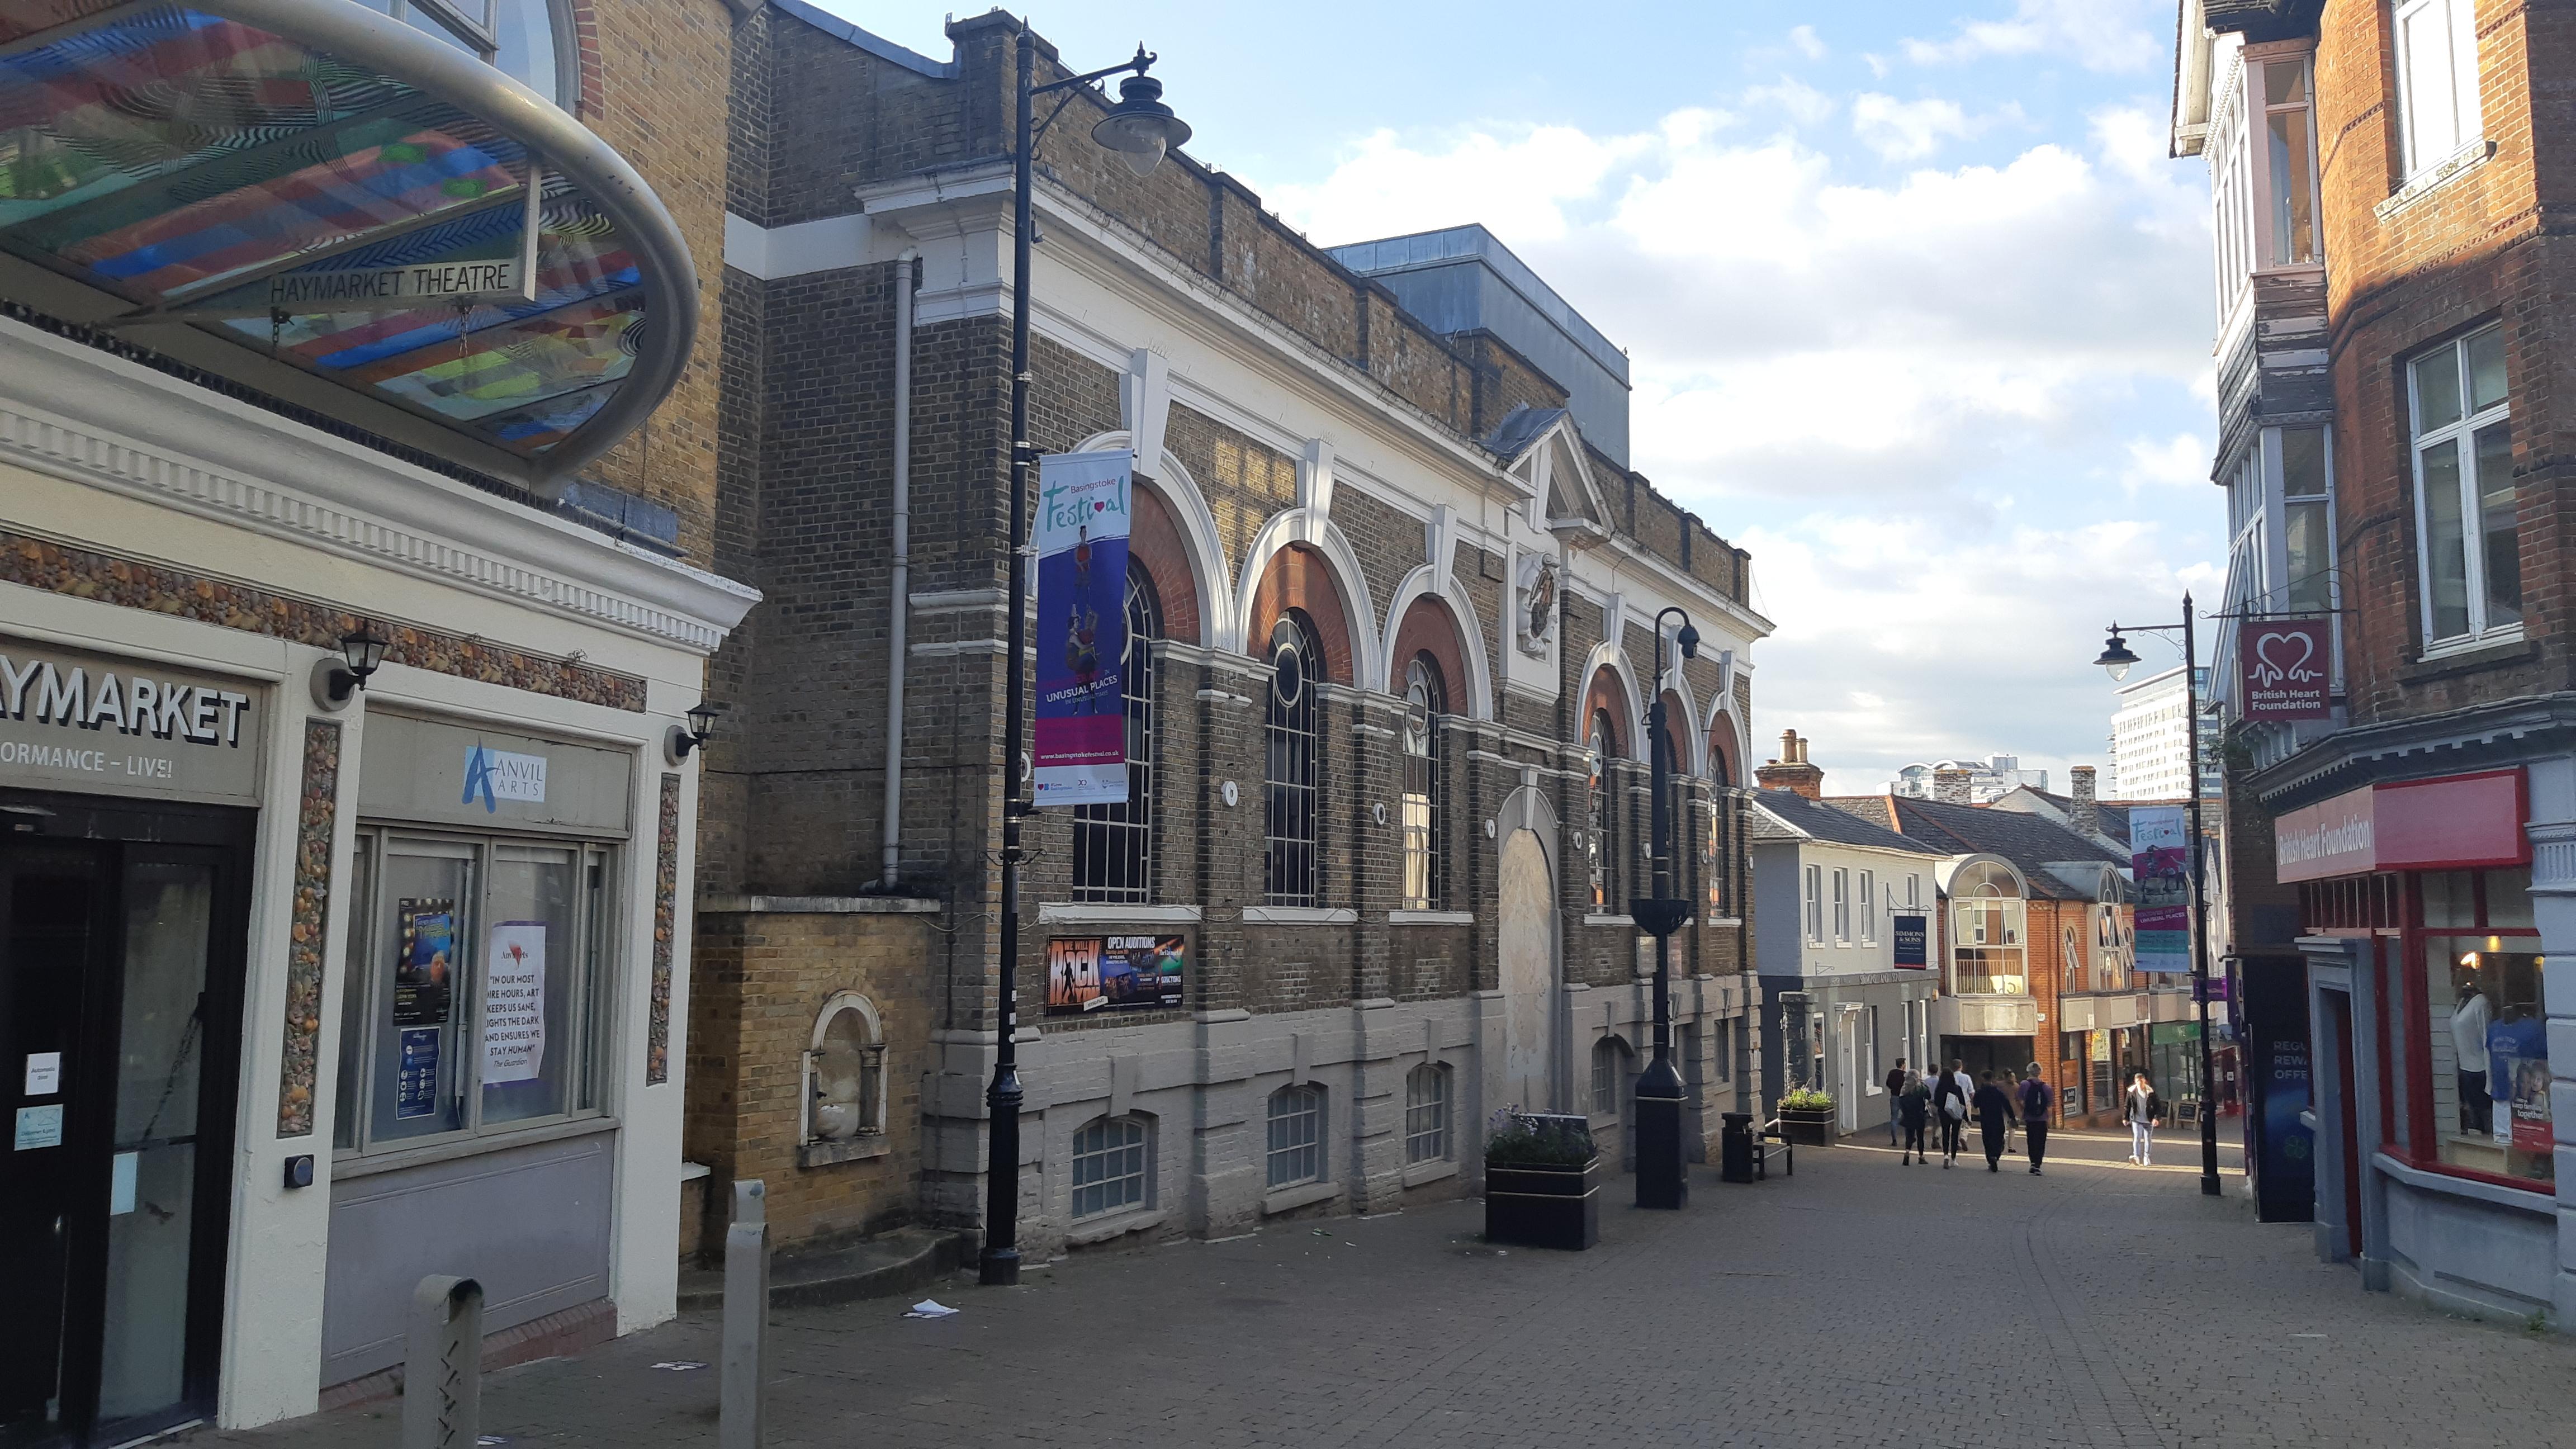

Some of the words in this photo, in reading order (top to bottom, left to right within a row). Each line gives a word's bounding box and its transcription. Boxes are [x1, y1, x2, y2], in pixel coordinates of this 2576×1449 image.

[271, 271, 405, 303] HAYMARKET
[413, 264, 510, 294] THEATRE
[1071, 479, 1116, 494] Basingstoke
[1046, 685, 1088, 703] UNUSUAL
[1090, 675, 1118, 691] PLACES
[2252, 690, 2286, 699] British
[2289, 689, 2320, 698] Heart
[2252, 699, 2321, 711] Foundation
[0, 741, 105, 772] ORMANCE
[127, 755, 173, 779] LIVE!
[1040, 750, 1119, 760] www.basingstokefestival.co.uk
[495, 759, 543, 782] ANVIL
[498, 779, 538, 796] ARTS
[2279, 828, 2300, 865] British
[2300, 828, 2321, 861] Heart
[2321, 814, 2370, 857] Foundation
[1107, 936, 1124, 949] OPEN
[1125, 936, 1156, 949] AUDITIONS
[1050, 940, 1101, 1004] ROCK
[501, 975, 515, 984] OUR
[517, 974, 534, 983] MOST
[1156, 976, 1181, 984] PODUCTIONS
[501, 989, 525, 998] HOURS,
[527, 988, 539, 997] ART
[487, 1004, 506, 1013] KEEPS
[508, 1003, 516, 1012] US
[518, 1002, 536, 1011] SANE,
[508, 1017, 520, 1026] THE
[522, 1016, 539, 1025] DARK
[485, 1033, 499, 1043] AND
[501, 1030, 529, 1041] ENSURES
[531, 1030, 540, 1038] WE
[490, 1046, 507, 1056] STAY
[2517, 1109, 2544, 1120] together
